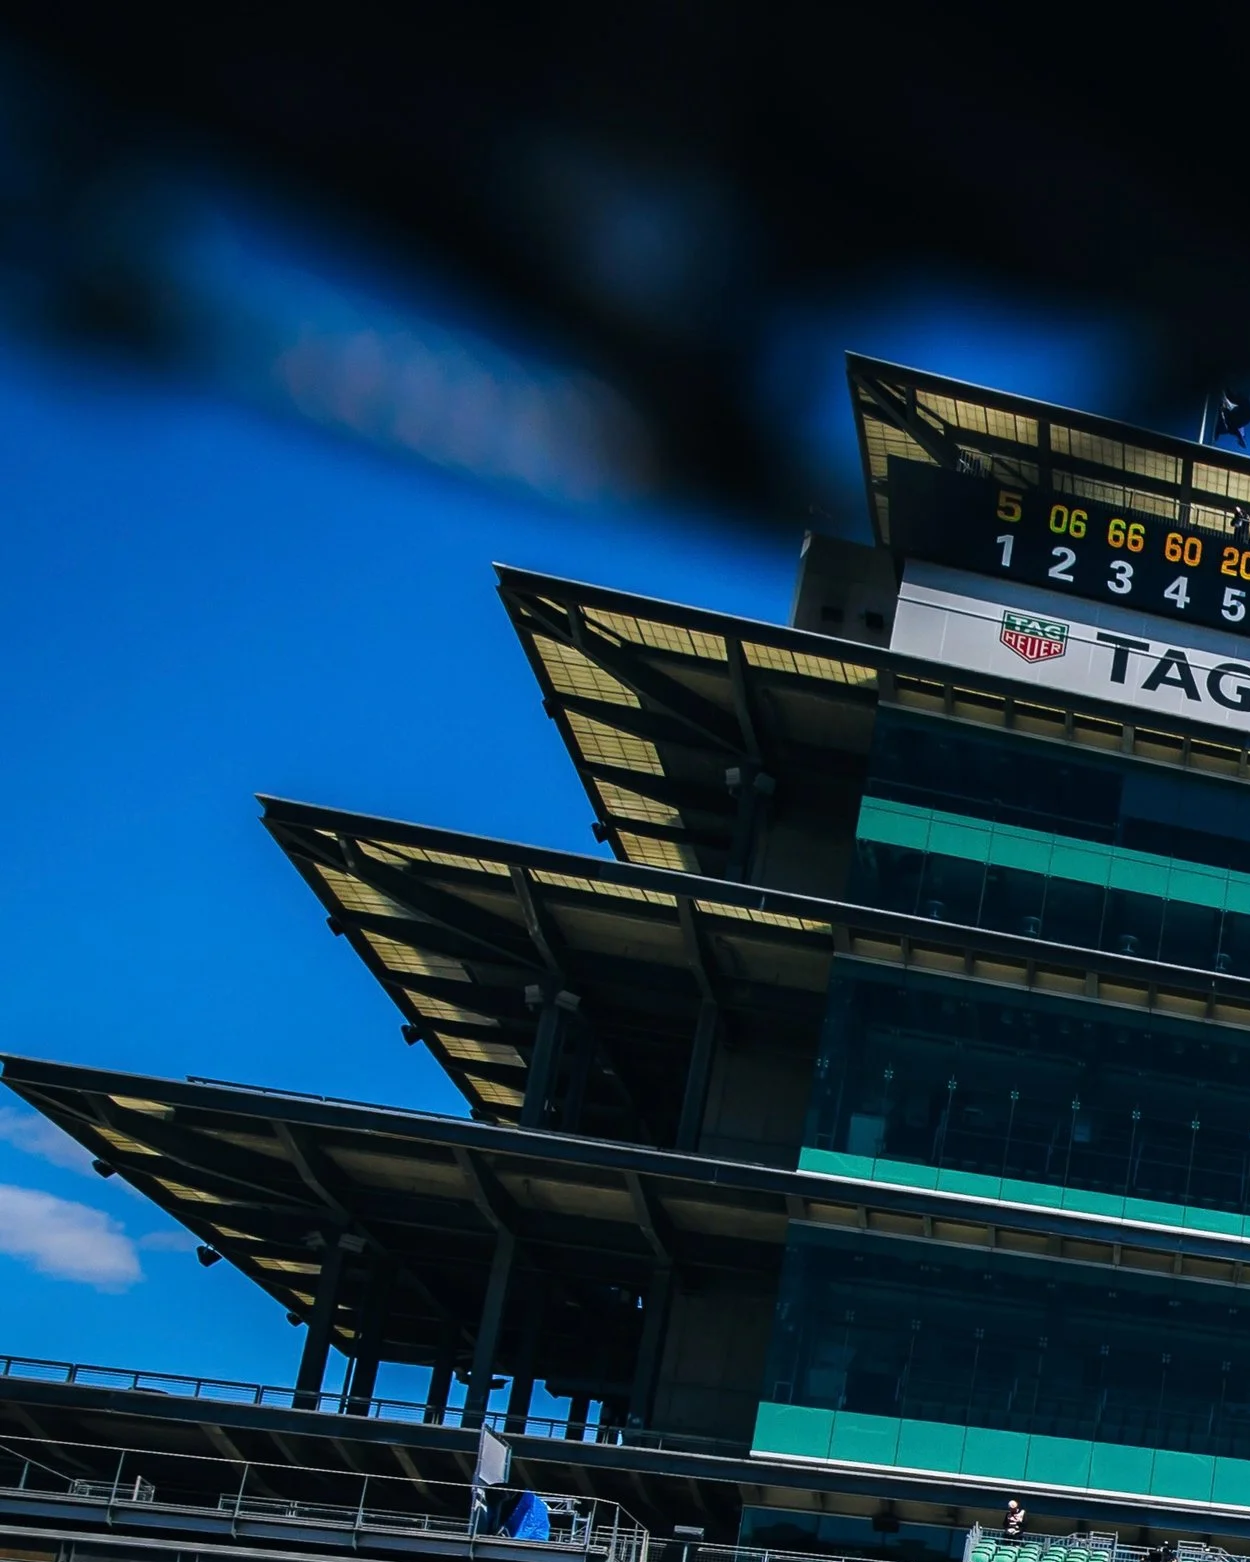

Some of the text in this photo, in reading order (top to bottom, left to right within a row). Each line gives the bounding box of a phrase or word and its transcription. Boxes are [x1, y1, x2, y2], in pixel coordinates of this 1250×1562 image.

[996, 490, 1022, 522] 5
[1050, 504, 1088, 538] 06
[1107, 518, 1145, 552] 66
[1164, 532, 1202, 567] 60
[996, 534, 1014, 568] 1
[1048, 546, 1077, 582] 2
[1106, 560, 1134, 595] 3
[1163, 576, 1190, 609] 4
[1221, 587, 1246, 622] 5
[1004, 632, 1061, 659] HEUER
[1009, 615, 1062, 640] TAG
